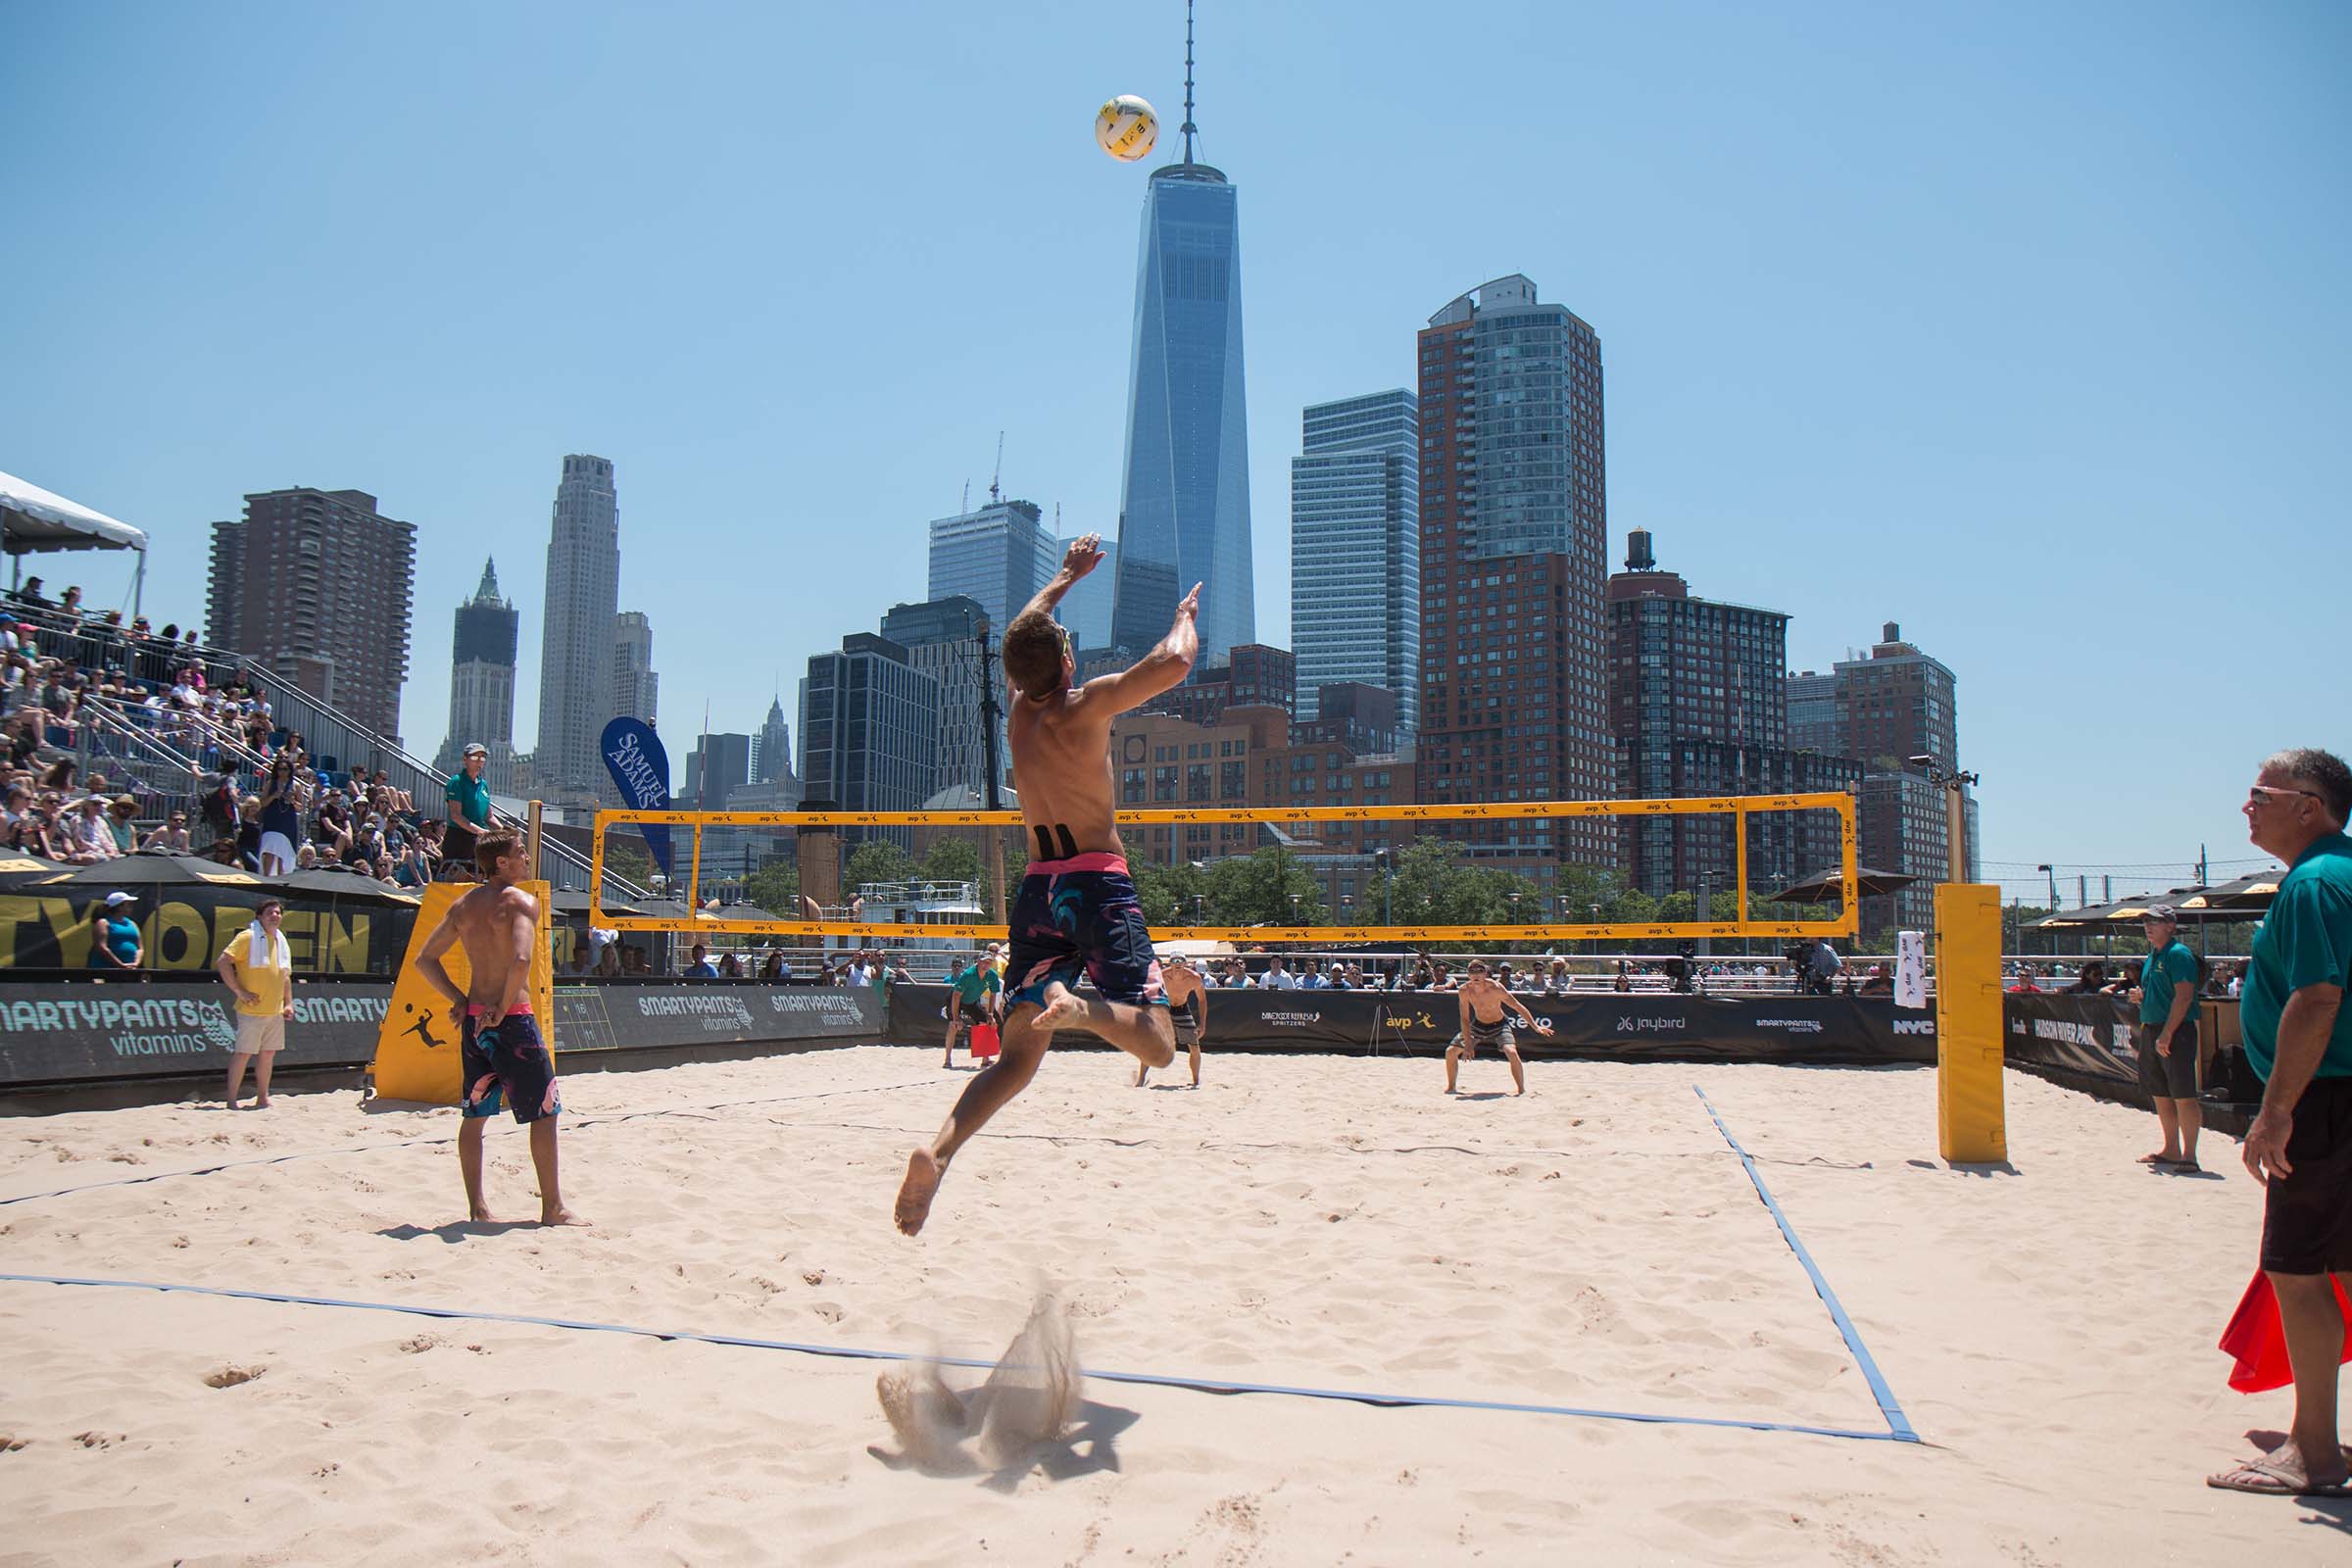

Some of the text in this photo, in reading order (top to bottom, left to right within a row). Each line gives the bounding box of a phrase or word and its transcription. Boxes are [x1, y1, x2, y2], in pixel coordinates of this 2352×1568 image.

[607, 750, 654, 809] ADAMS
[618, 733, 667, 808] SAMUEL
[1584, 806, 1600, 814] avp
[293, 997, 392, 1024] SMARTY
[638, 996, 736, 1016] SMARTYPANTS
[770, 995, 848, 1012] SMARTYPANTS
[0, 999, 195, 1032] ARTYPANTS
[701, 1013, 741, 1031] vitamins
[820, 1012, 853, 1026] vitamins
[1386, 1017, 1412, 1030] avp
[1892, 1019, 1936, 1035] NYC
[110, 1029, 207, 1056] vitamins
